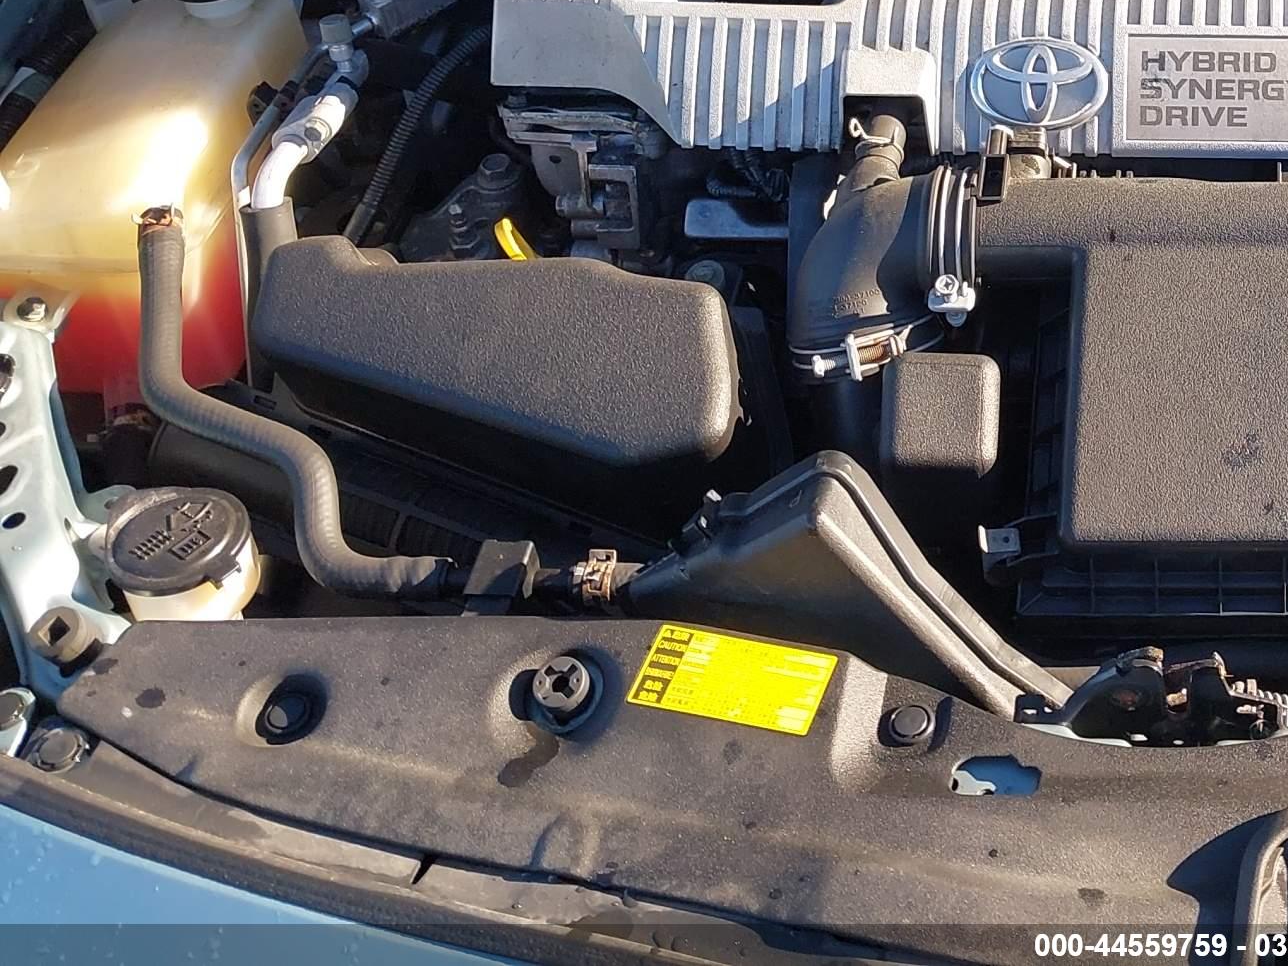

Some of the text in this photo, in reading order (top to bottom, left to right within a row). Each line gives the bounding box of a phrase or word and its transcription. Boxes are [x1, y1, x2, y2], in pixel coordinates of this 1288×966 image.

[1141, 50, 1277, 73] HYBRID
[1139, 105, 1248, 128] DRIVE
[657, 640, 689, 652] CAUTION
